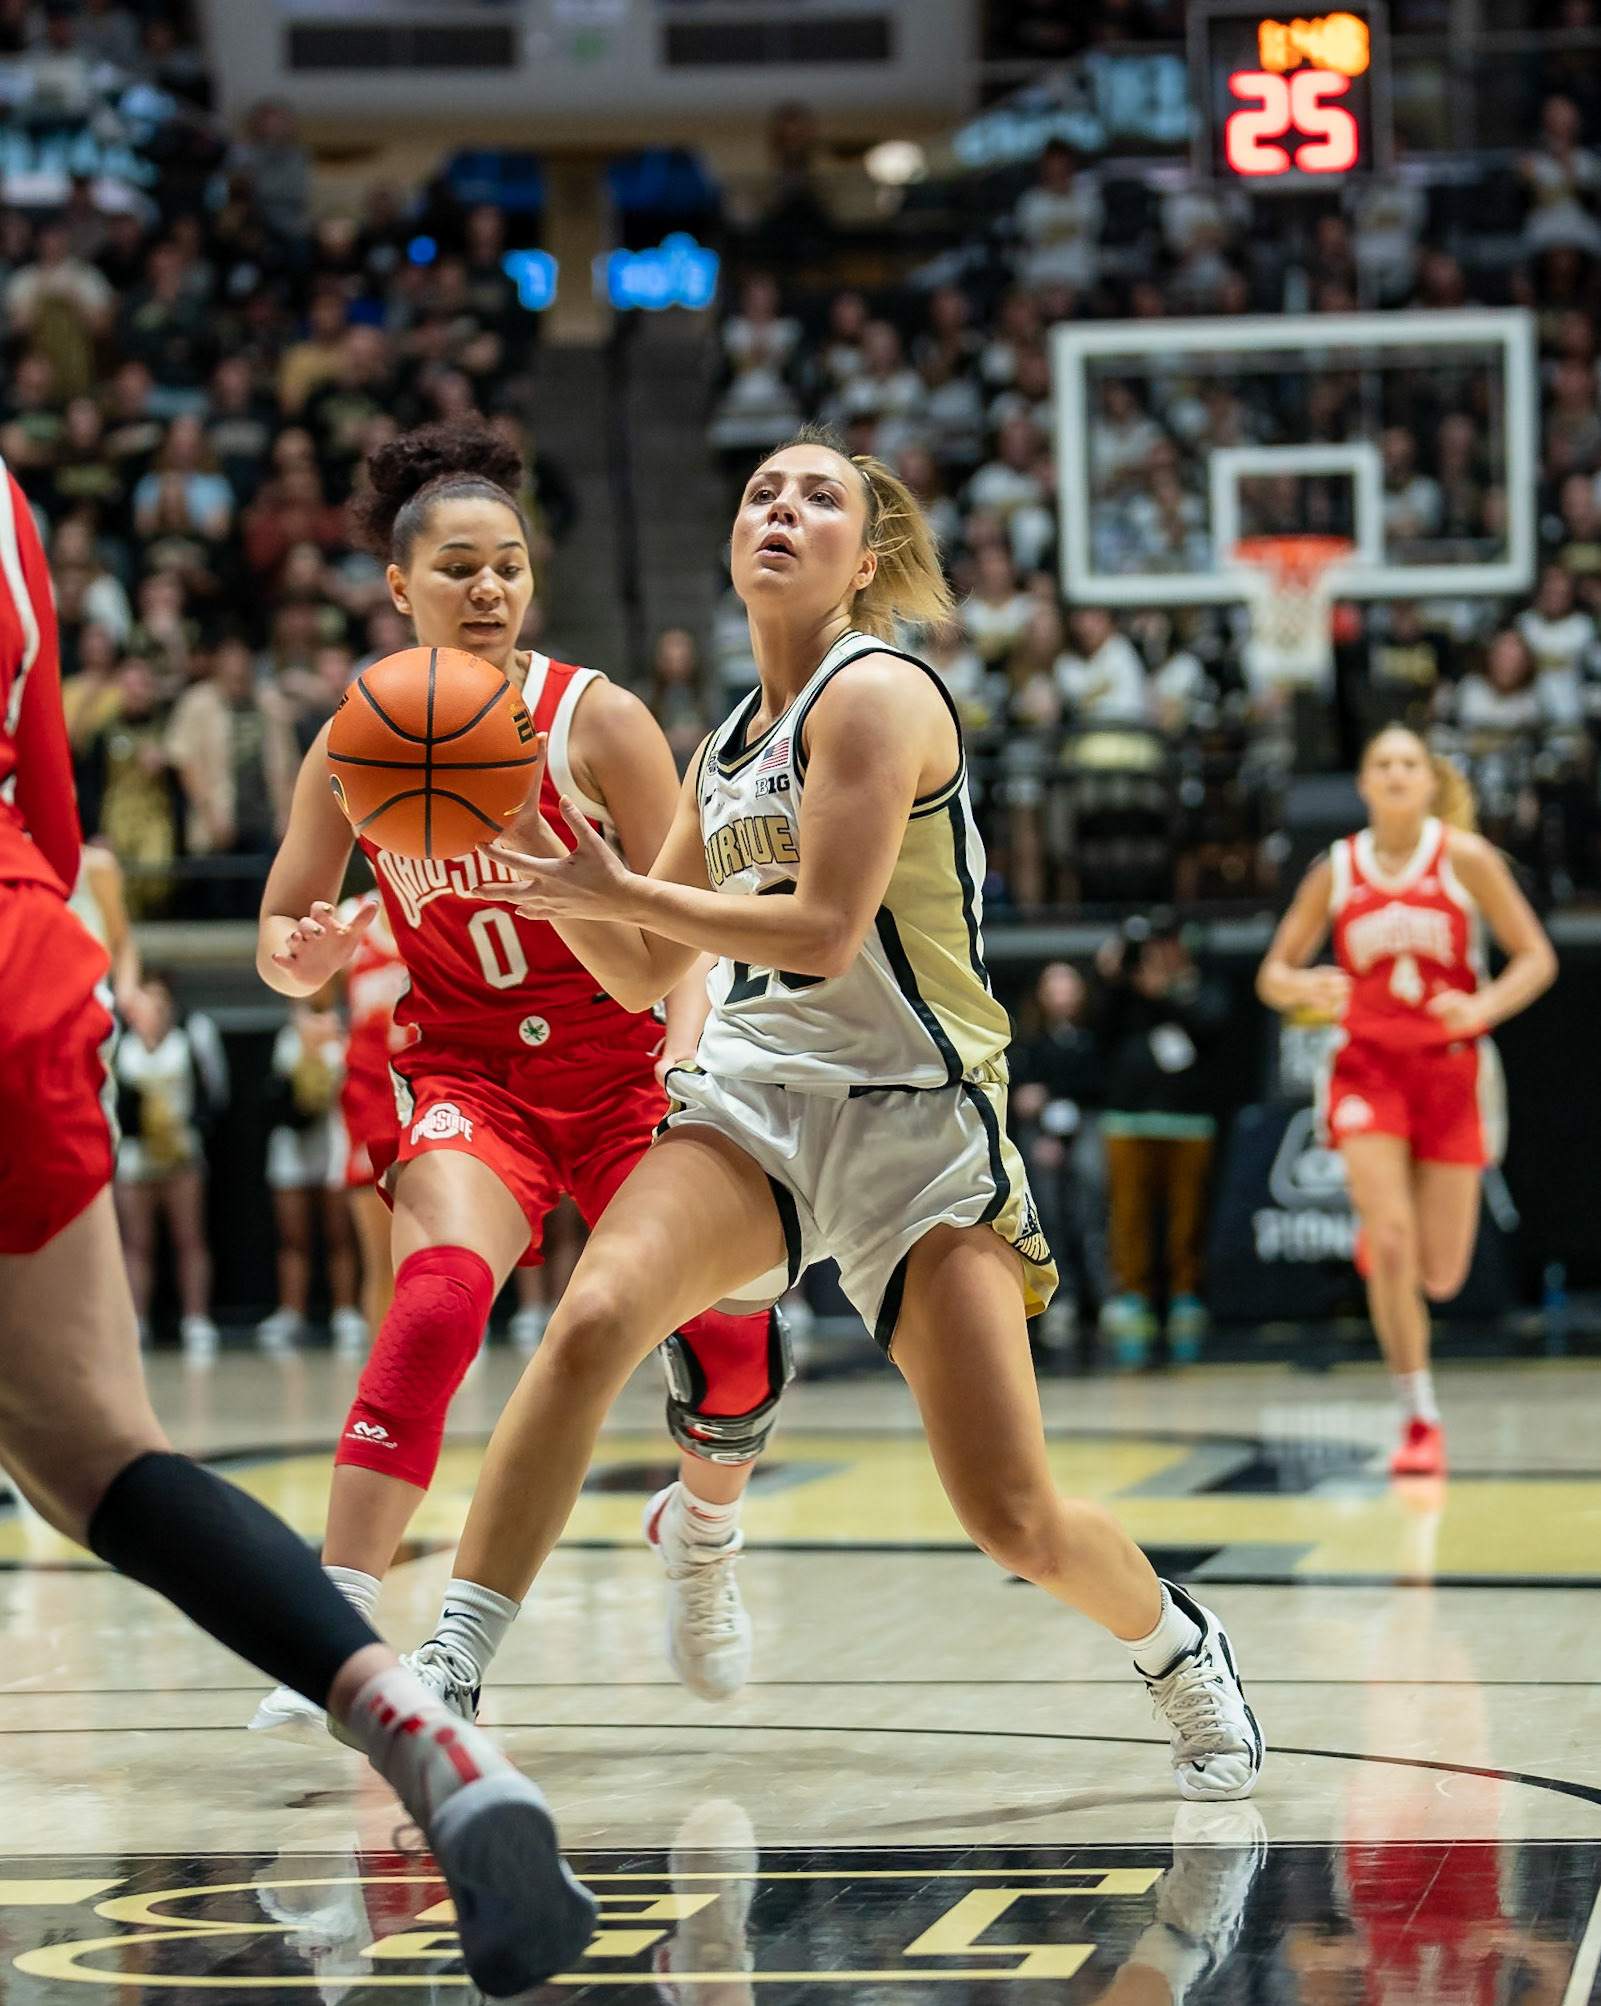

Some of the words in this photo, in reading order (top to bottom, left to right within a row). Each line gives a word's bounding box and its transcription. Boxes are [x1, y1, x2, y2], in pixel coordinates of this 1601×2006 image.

[1225, 69, 1359, 176] 25
[705, 815, 800, 886] URDUE
[468, 907, 529, 990] 0
[1014, 1232, 1051, 1261] PURD
